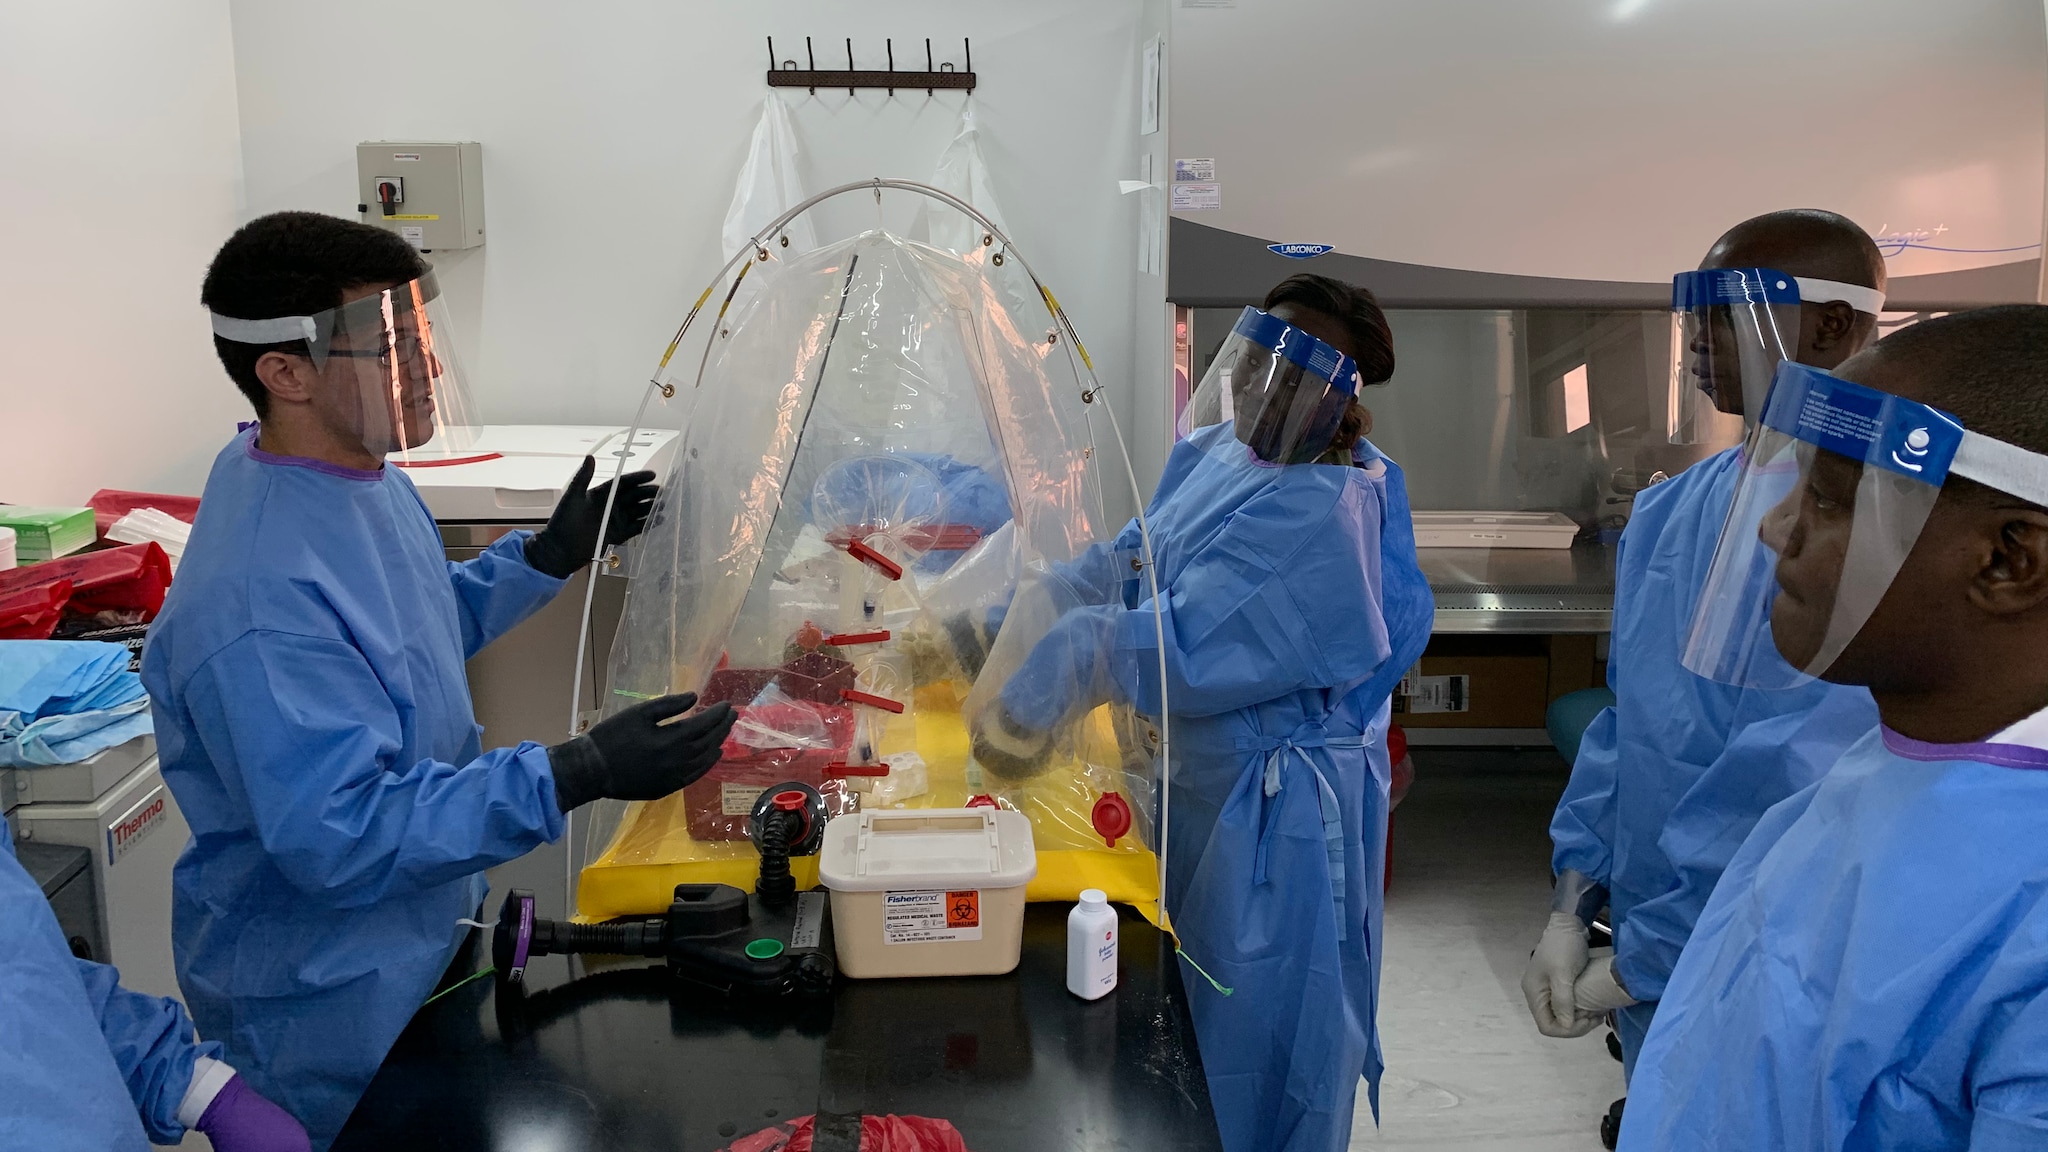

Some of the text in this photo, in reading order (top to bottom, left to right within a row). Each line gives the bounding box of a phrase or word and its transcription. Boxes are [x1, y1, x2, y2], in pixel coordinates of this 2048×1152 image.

[1281, 245, 1323, 254] LABCONCO
[1825, 404, 1843, 414] against
[1829, 424, 1854, 436] protection
[1839, 421, 1857, 430] impact
[114, 799, 163, 845] Thermo
[888, 895, 938, 903] Fisherbrand
[948, 920, 978, 928] BIOHAZARD
